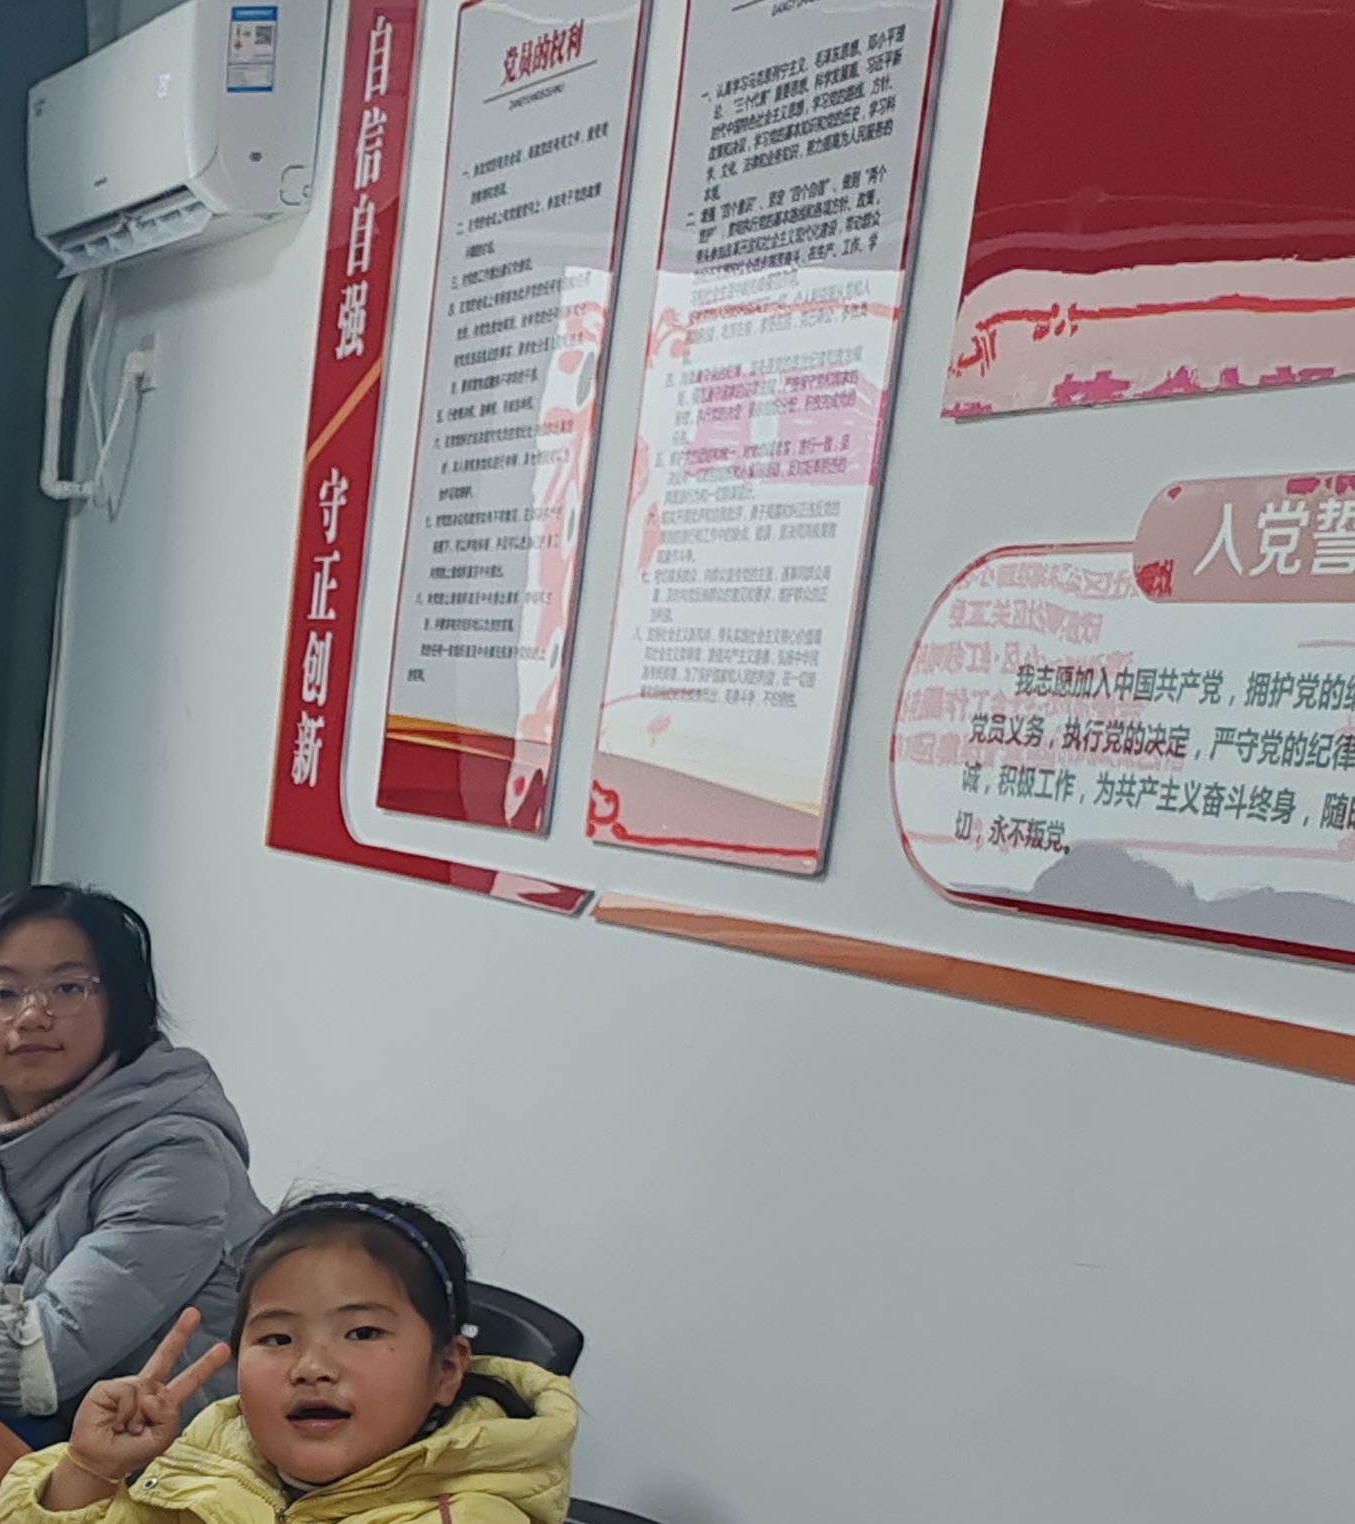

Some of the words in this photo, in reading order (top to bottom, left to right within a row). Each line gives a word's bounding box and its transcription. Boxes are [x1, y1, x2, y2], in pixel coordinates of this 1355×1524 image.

[335, 15, 392, 360] 自信自强
[500, 19, 584, 87] 党员的权利
[291, 467, 349, 788] 守正创新
